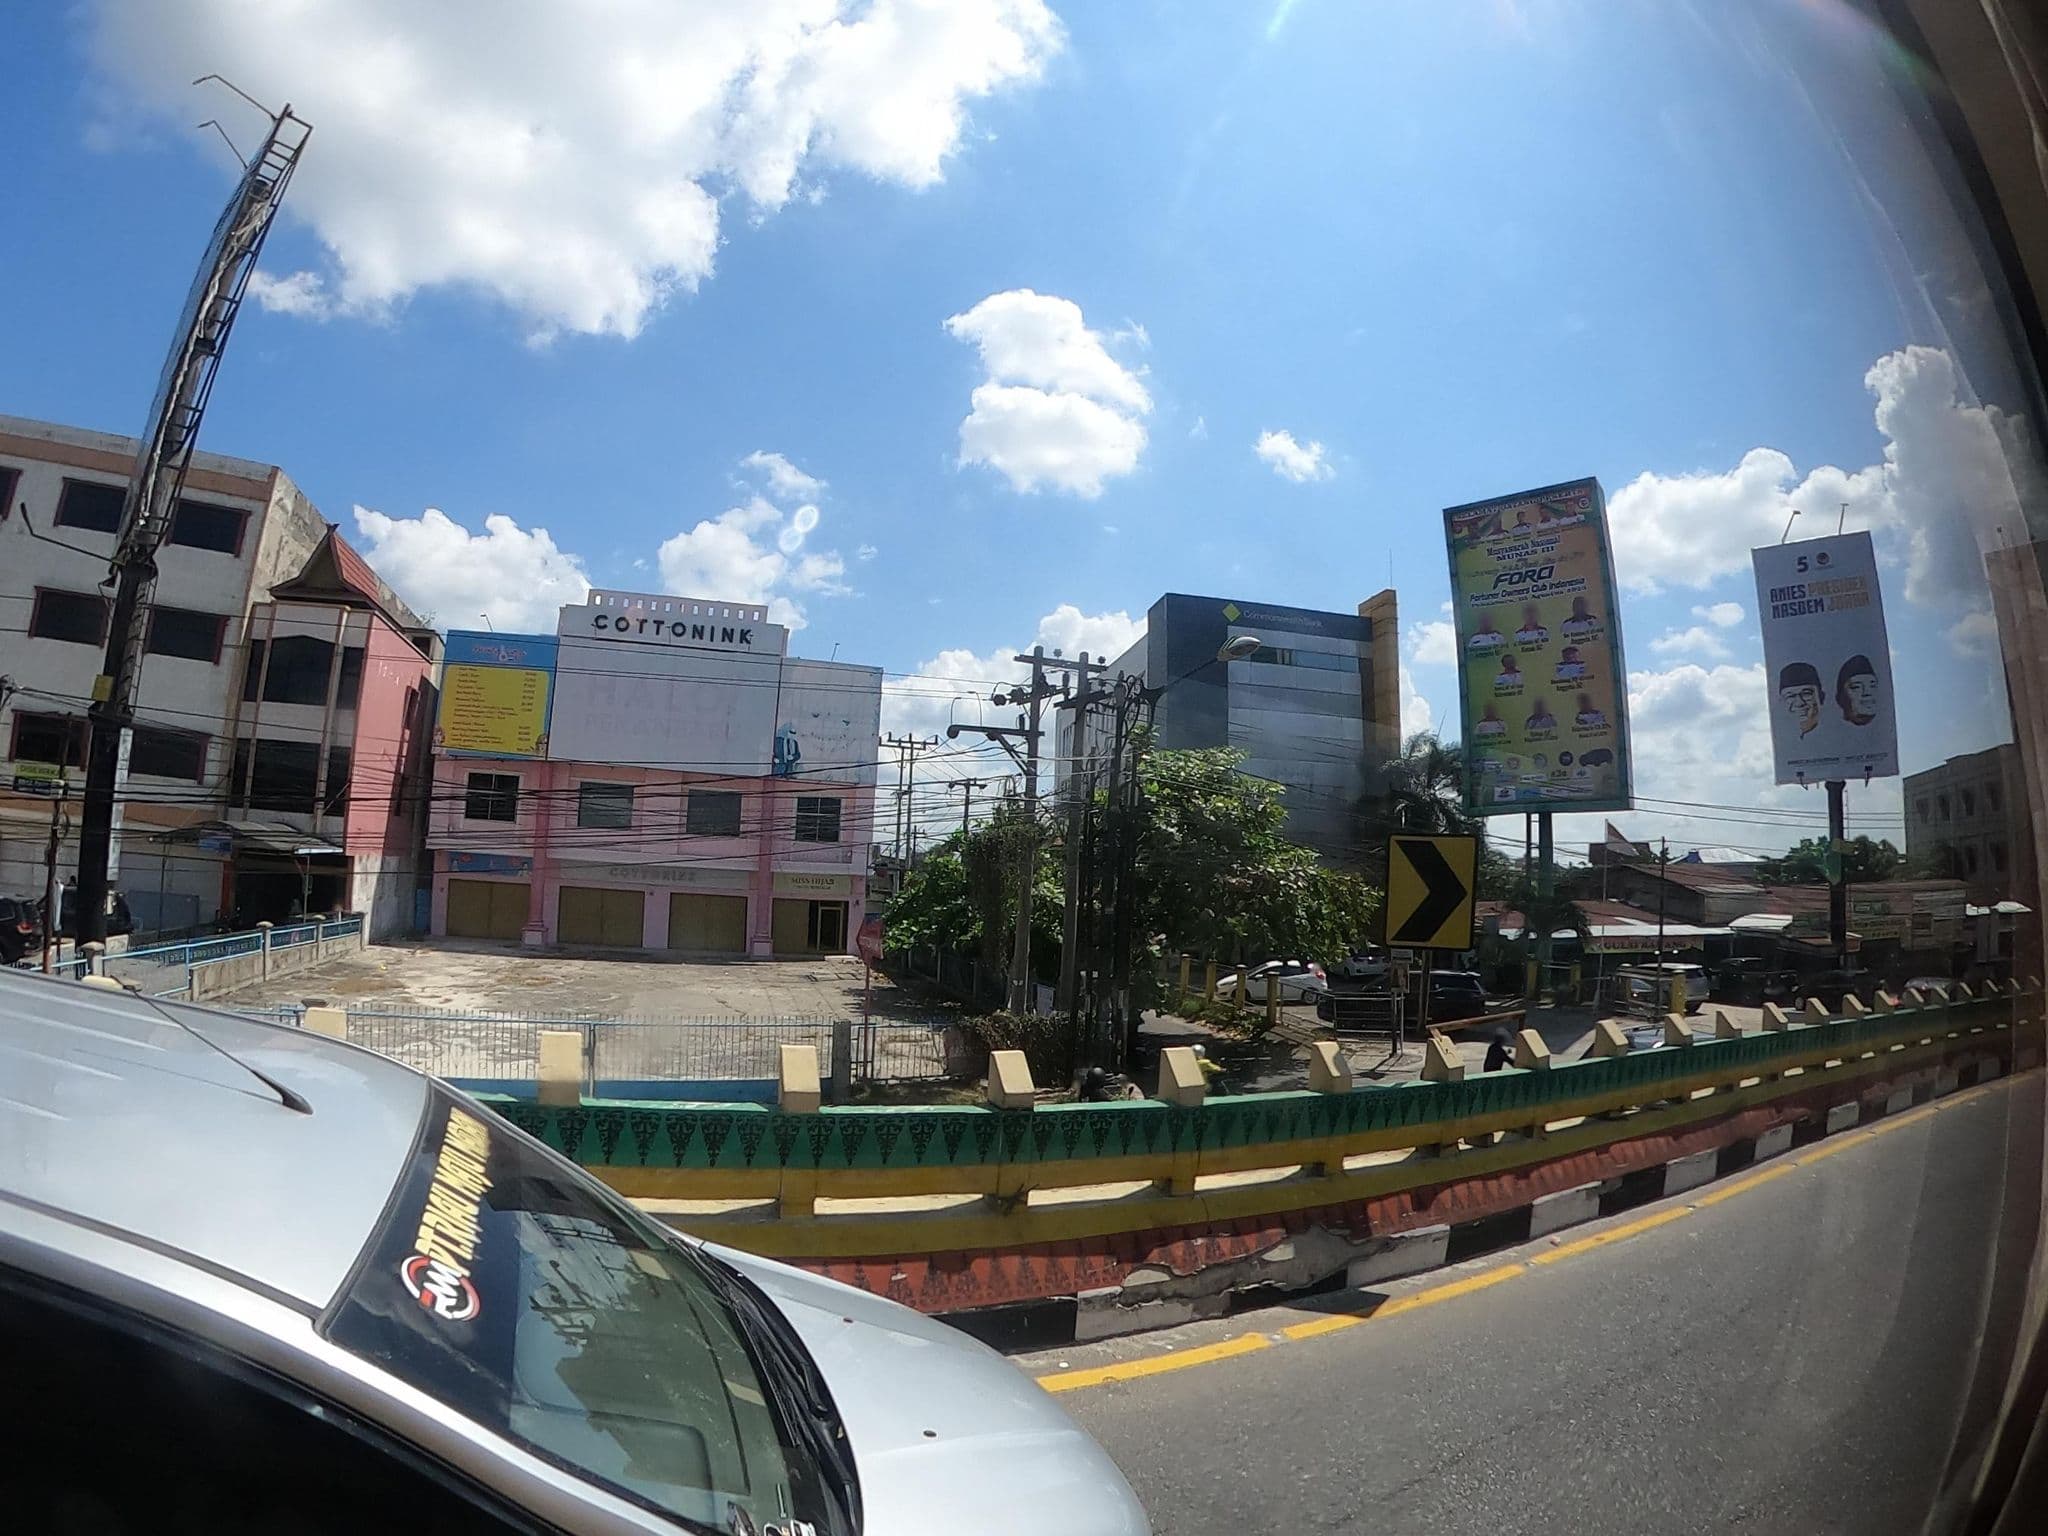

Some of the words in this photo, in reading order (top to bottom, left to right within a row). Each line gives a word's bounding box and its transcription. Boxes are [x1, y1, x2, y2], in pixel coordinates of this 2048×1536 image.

[1496, 549, 1537, 561] MUNAS
[1797, 556, 1809, 573] 5
[1770, 584, 1806, 603] ANIES
[1772, 597, 1825, 620] NASDEM
[594, 614, 752, 645] COTTONINK
